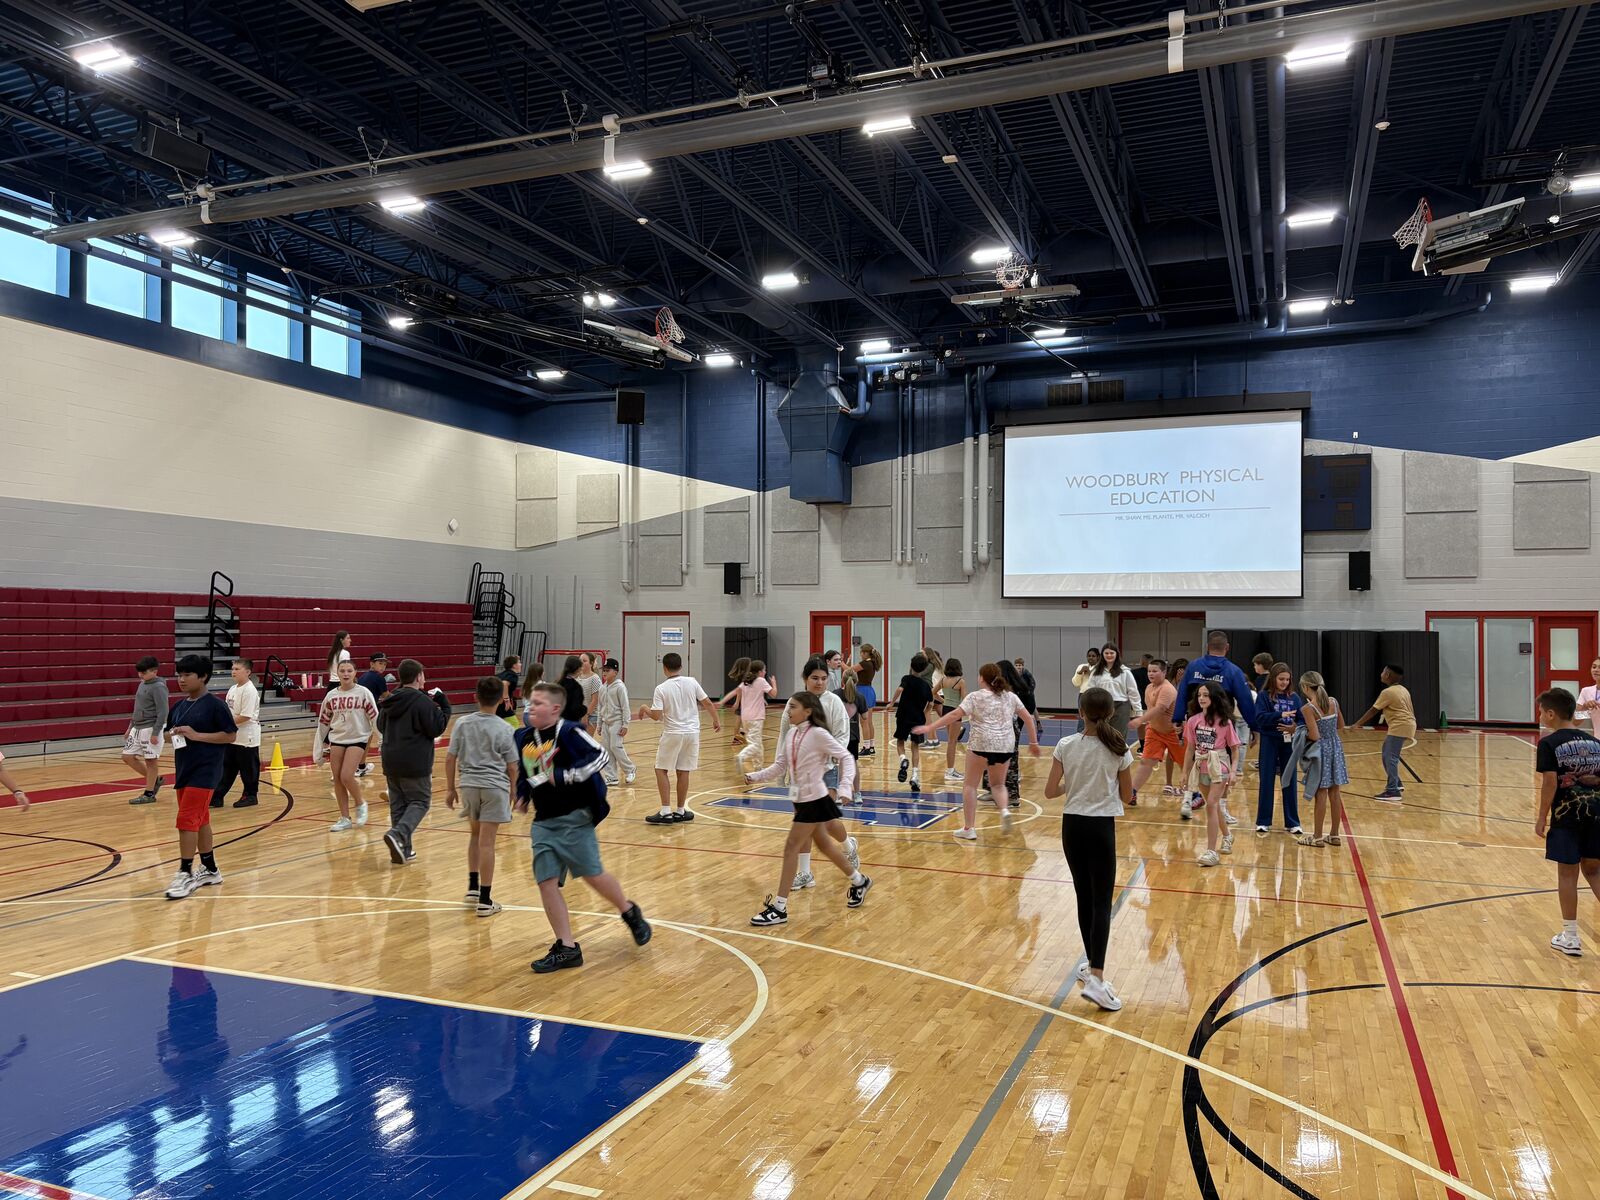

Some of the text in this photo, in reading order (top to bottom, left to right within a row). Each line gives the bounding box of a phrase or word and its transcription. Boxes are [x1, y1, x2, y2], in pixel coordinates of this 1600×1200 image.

[1065, 467, 1264, 488] WOODBURY PHYSICAL
[1110, 489, 1215, 506] EDUCATION
